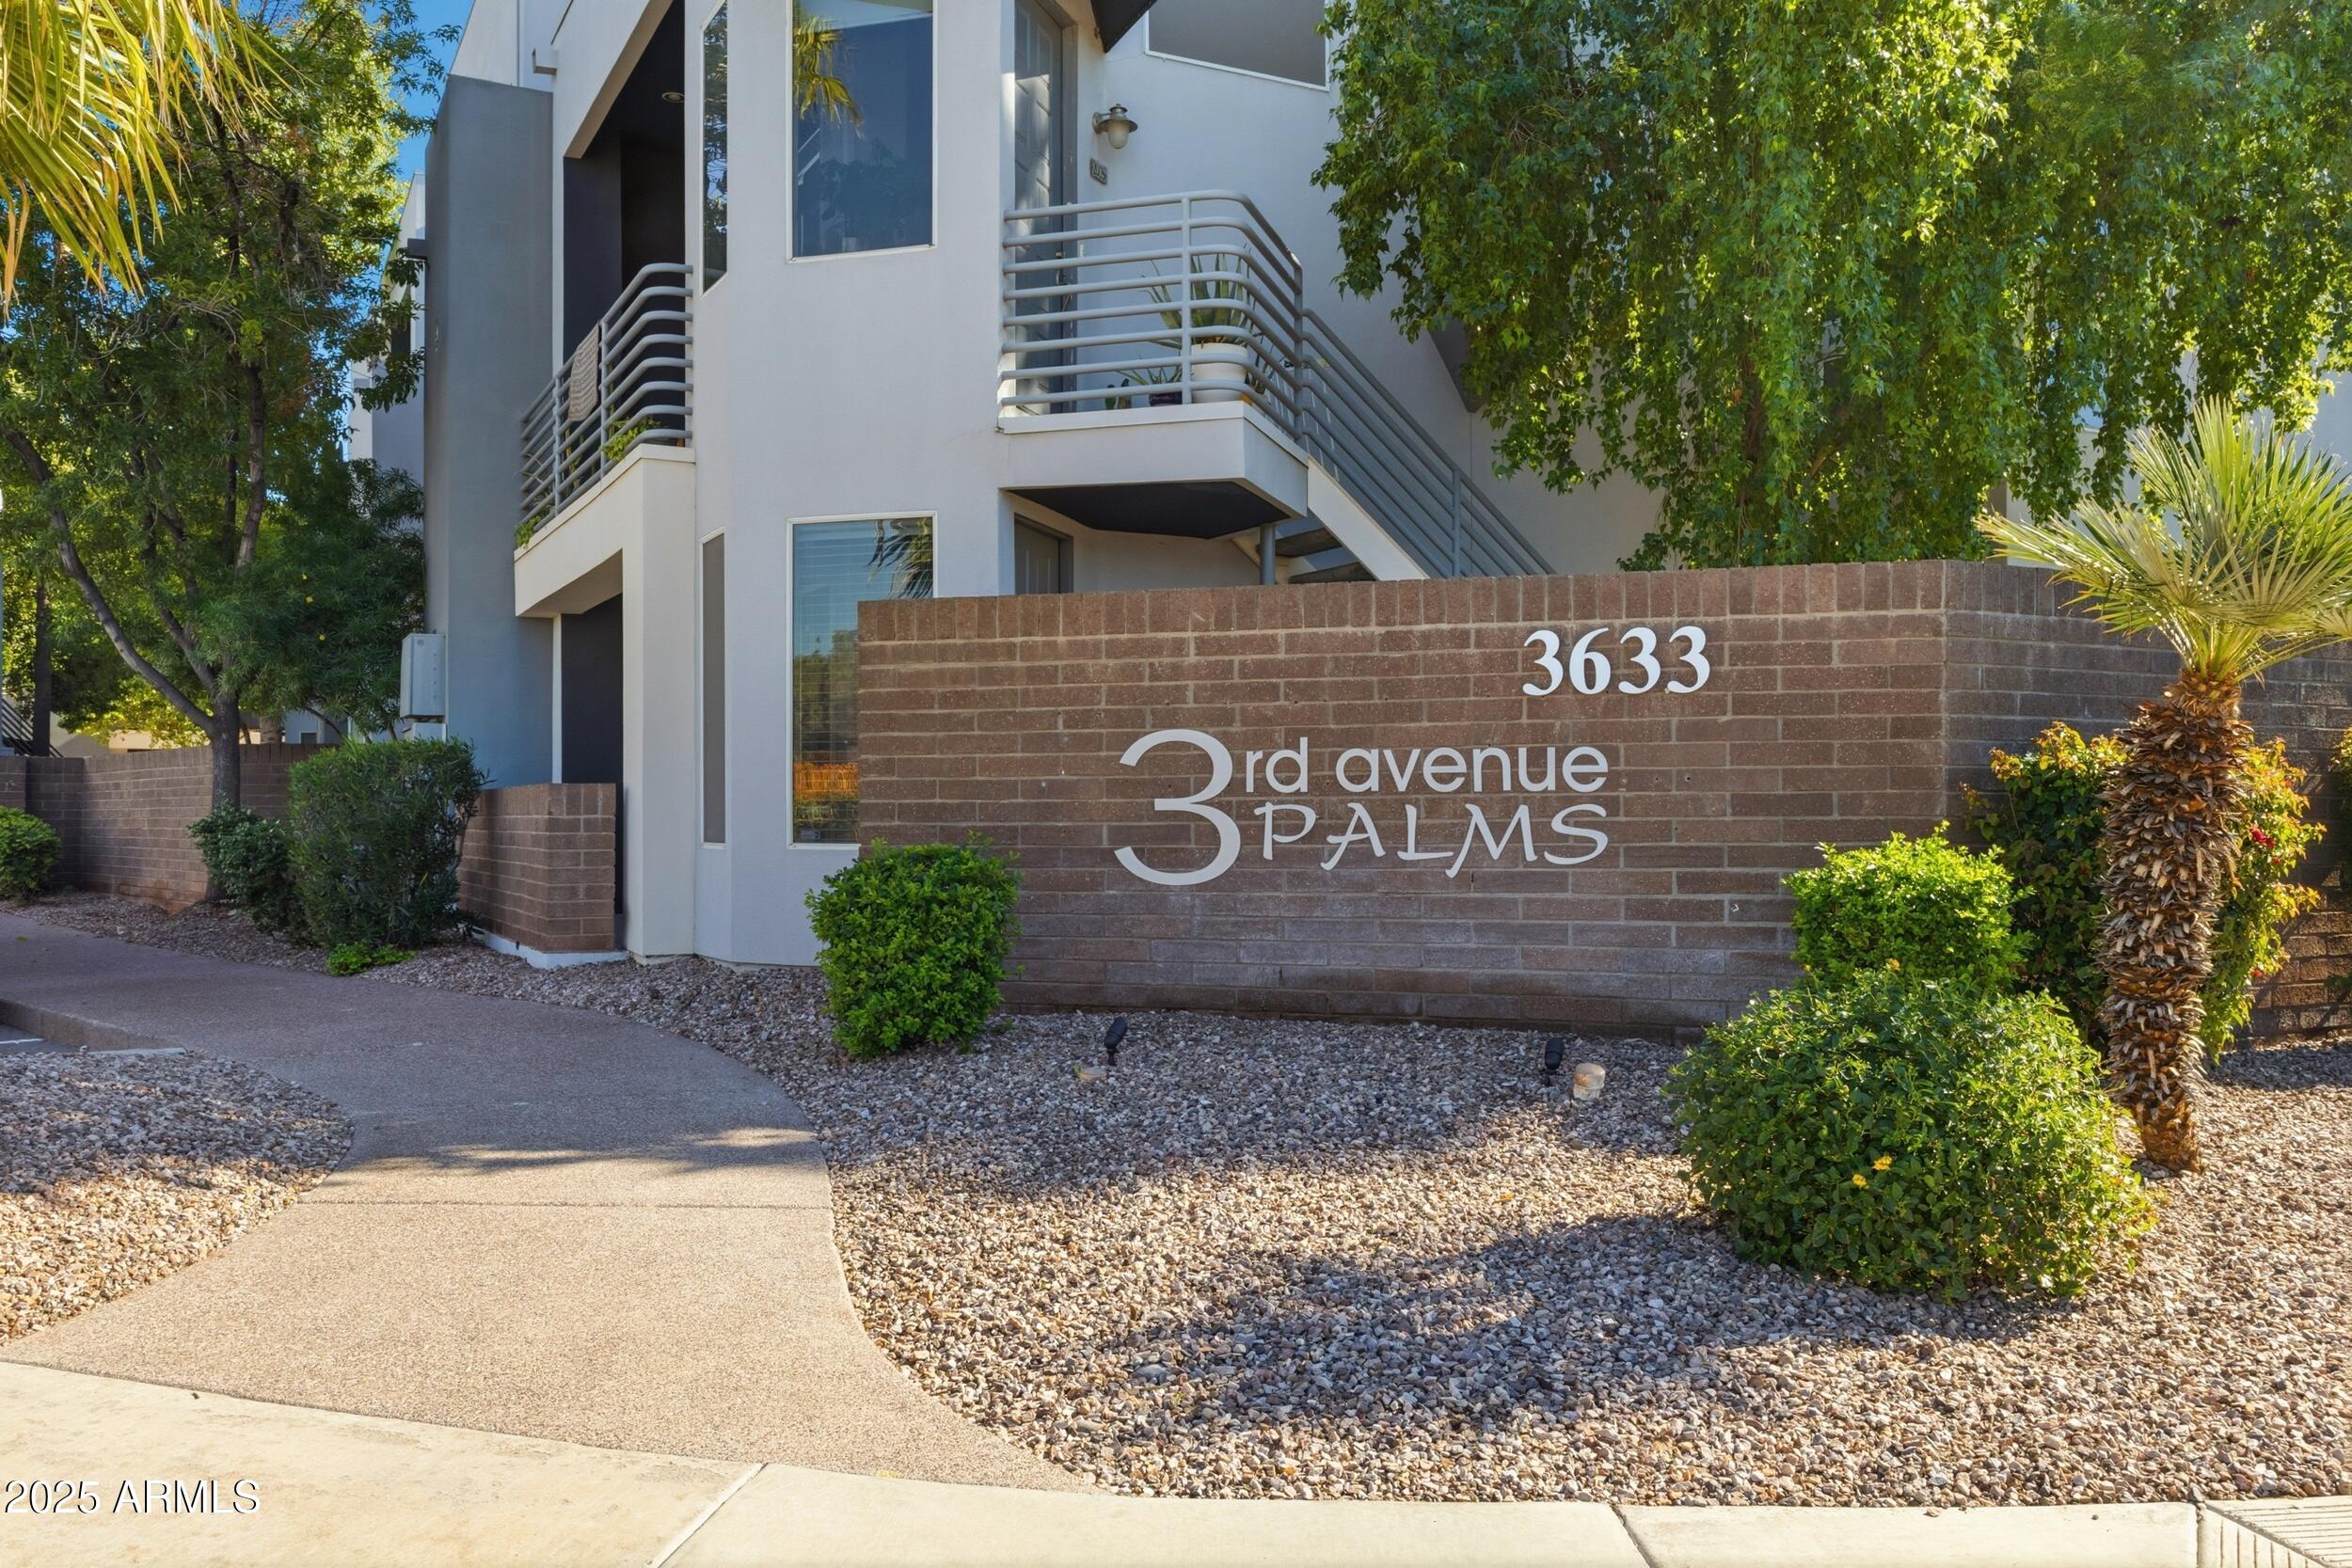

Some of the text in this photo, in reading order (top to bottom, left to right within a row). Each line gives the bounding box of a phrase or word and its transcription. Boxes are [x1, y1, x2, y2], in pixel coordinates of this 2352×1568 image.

[1522, 626, 1710, 696] 3633
[1114, 729, 1609, 886] 3rd avenue
[1254, 800, 1609, 879] PALMS
